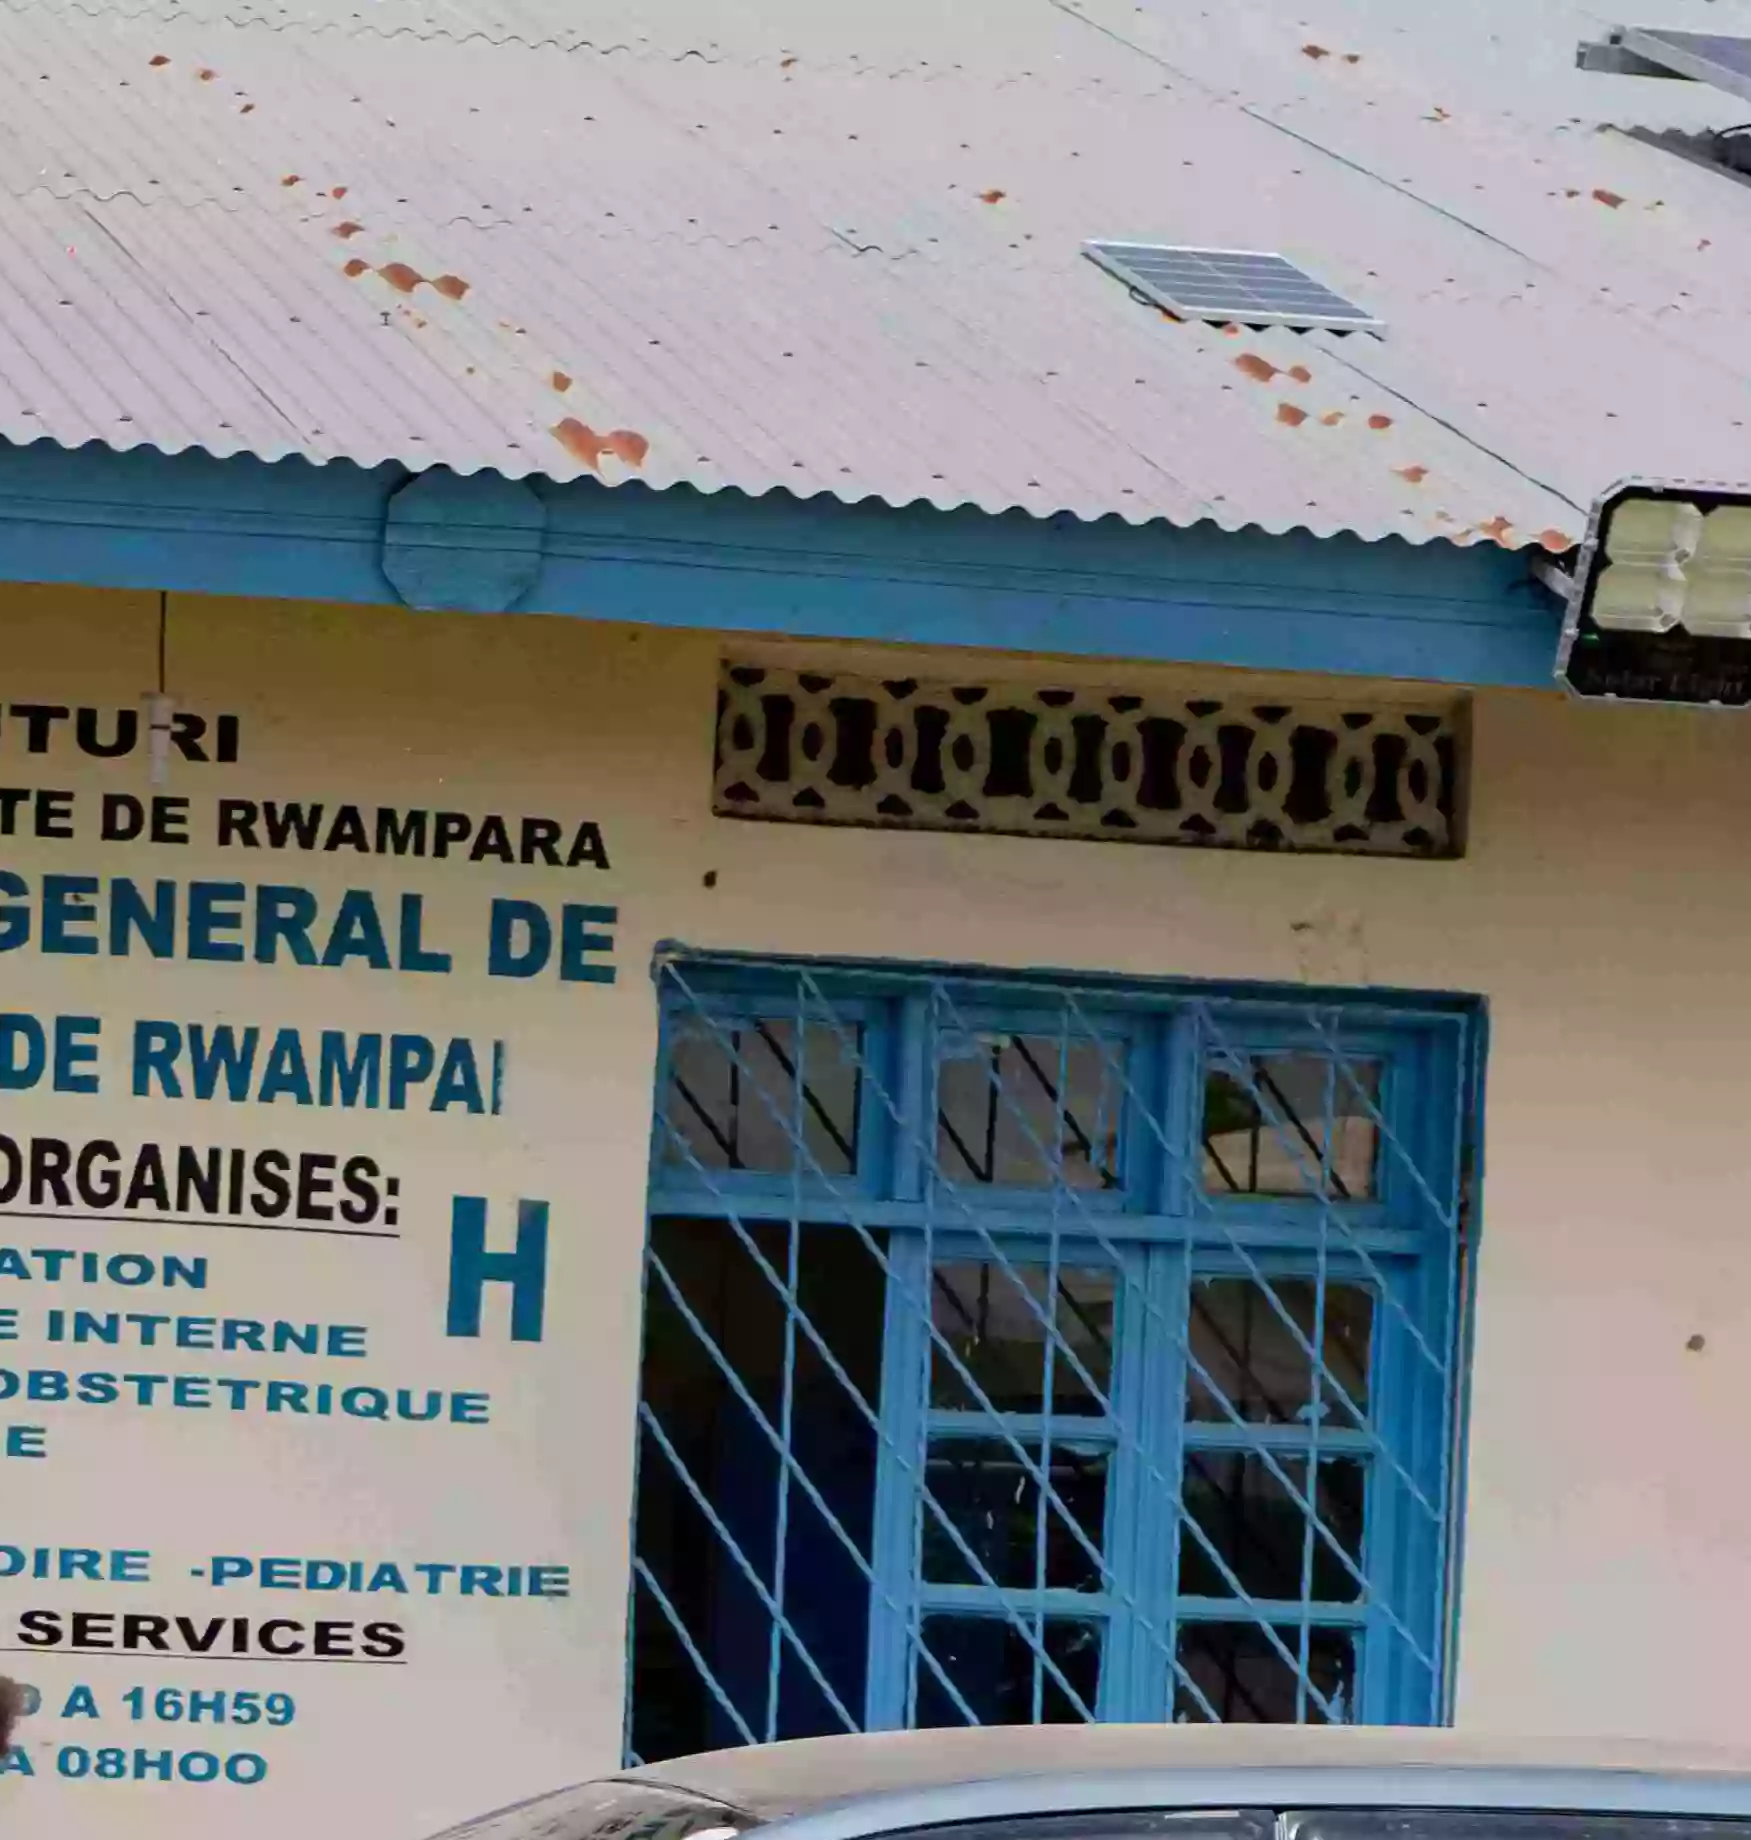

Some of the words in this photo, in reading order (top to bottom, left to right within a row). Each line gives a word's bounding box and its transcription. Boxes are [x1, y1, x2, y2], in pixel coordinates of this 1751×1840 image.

[101, 794, 189, 844] DE
[219, 800, 610, 868] RWAMPARA
[489, 899, 617, 983] DE
[133, 1021, 503, 1115] RWAMPA
[447, 1196, 549, 1342] H
[48, 1310, 365, 1357] INTERNE
[18, 1611, 405, 1659] SERVICES
[61, 1686, 99, 1718] A
[123, 1687, 295, 1725] 16H59
